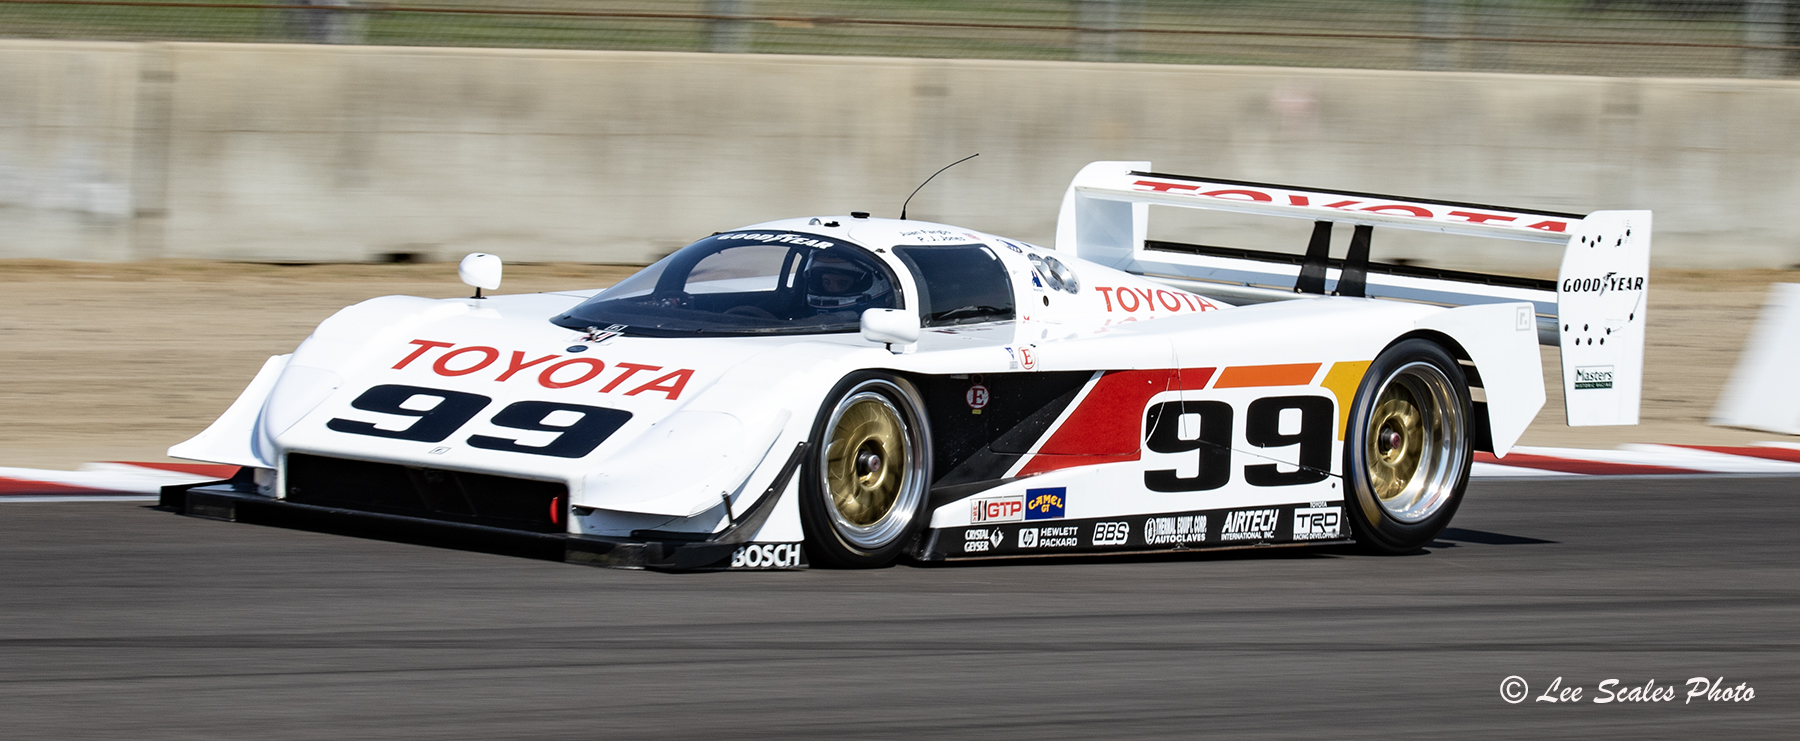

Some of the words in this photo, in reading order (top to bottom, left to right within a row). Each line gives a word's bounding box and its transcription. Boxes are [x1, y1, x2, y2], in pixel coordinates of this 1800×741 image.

[717, 233, 835, 249] GOODYEAR
[1563, 272, 1643, 297] GOODYEAR
[1095, 286, 1219, 313] TOYOTA
[391, 339, 695, 401] TOYOTA
[1576, 369, 1612, 381] Masters
[970, 387, 985, 406] E
[326, 383, 633, 459] 99
[1144, 395, 1335, 493] 99
[987, 500, 1022, 518] GTP
[1028, 494, 1063, 510] CAMEL
[1041, 504, 1050, 513] GT
[1222, 509, 1280, 534] AIRTECH
[1297, 512, 1338, 534] TRD
[965, 529, 990, 541] CRYSTAL
[1040, 526, 1079, 537] HEWLETT
[1092, 522, 1129, 545] BBS
[1154, 533, 1206, 544] AUTOCLAVES
[1221, 531, 1263, 541] INTERNATIONAL
[1264, 530, 1275, 539] INC.
[964, 541, 989, 553] GEYSER
[1039, 537, 1078, 548] PACKARD
[731, 543, 801, 568] BOSCH
